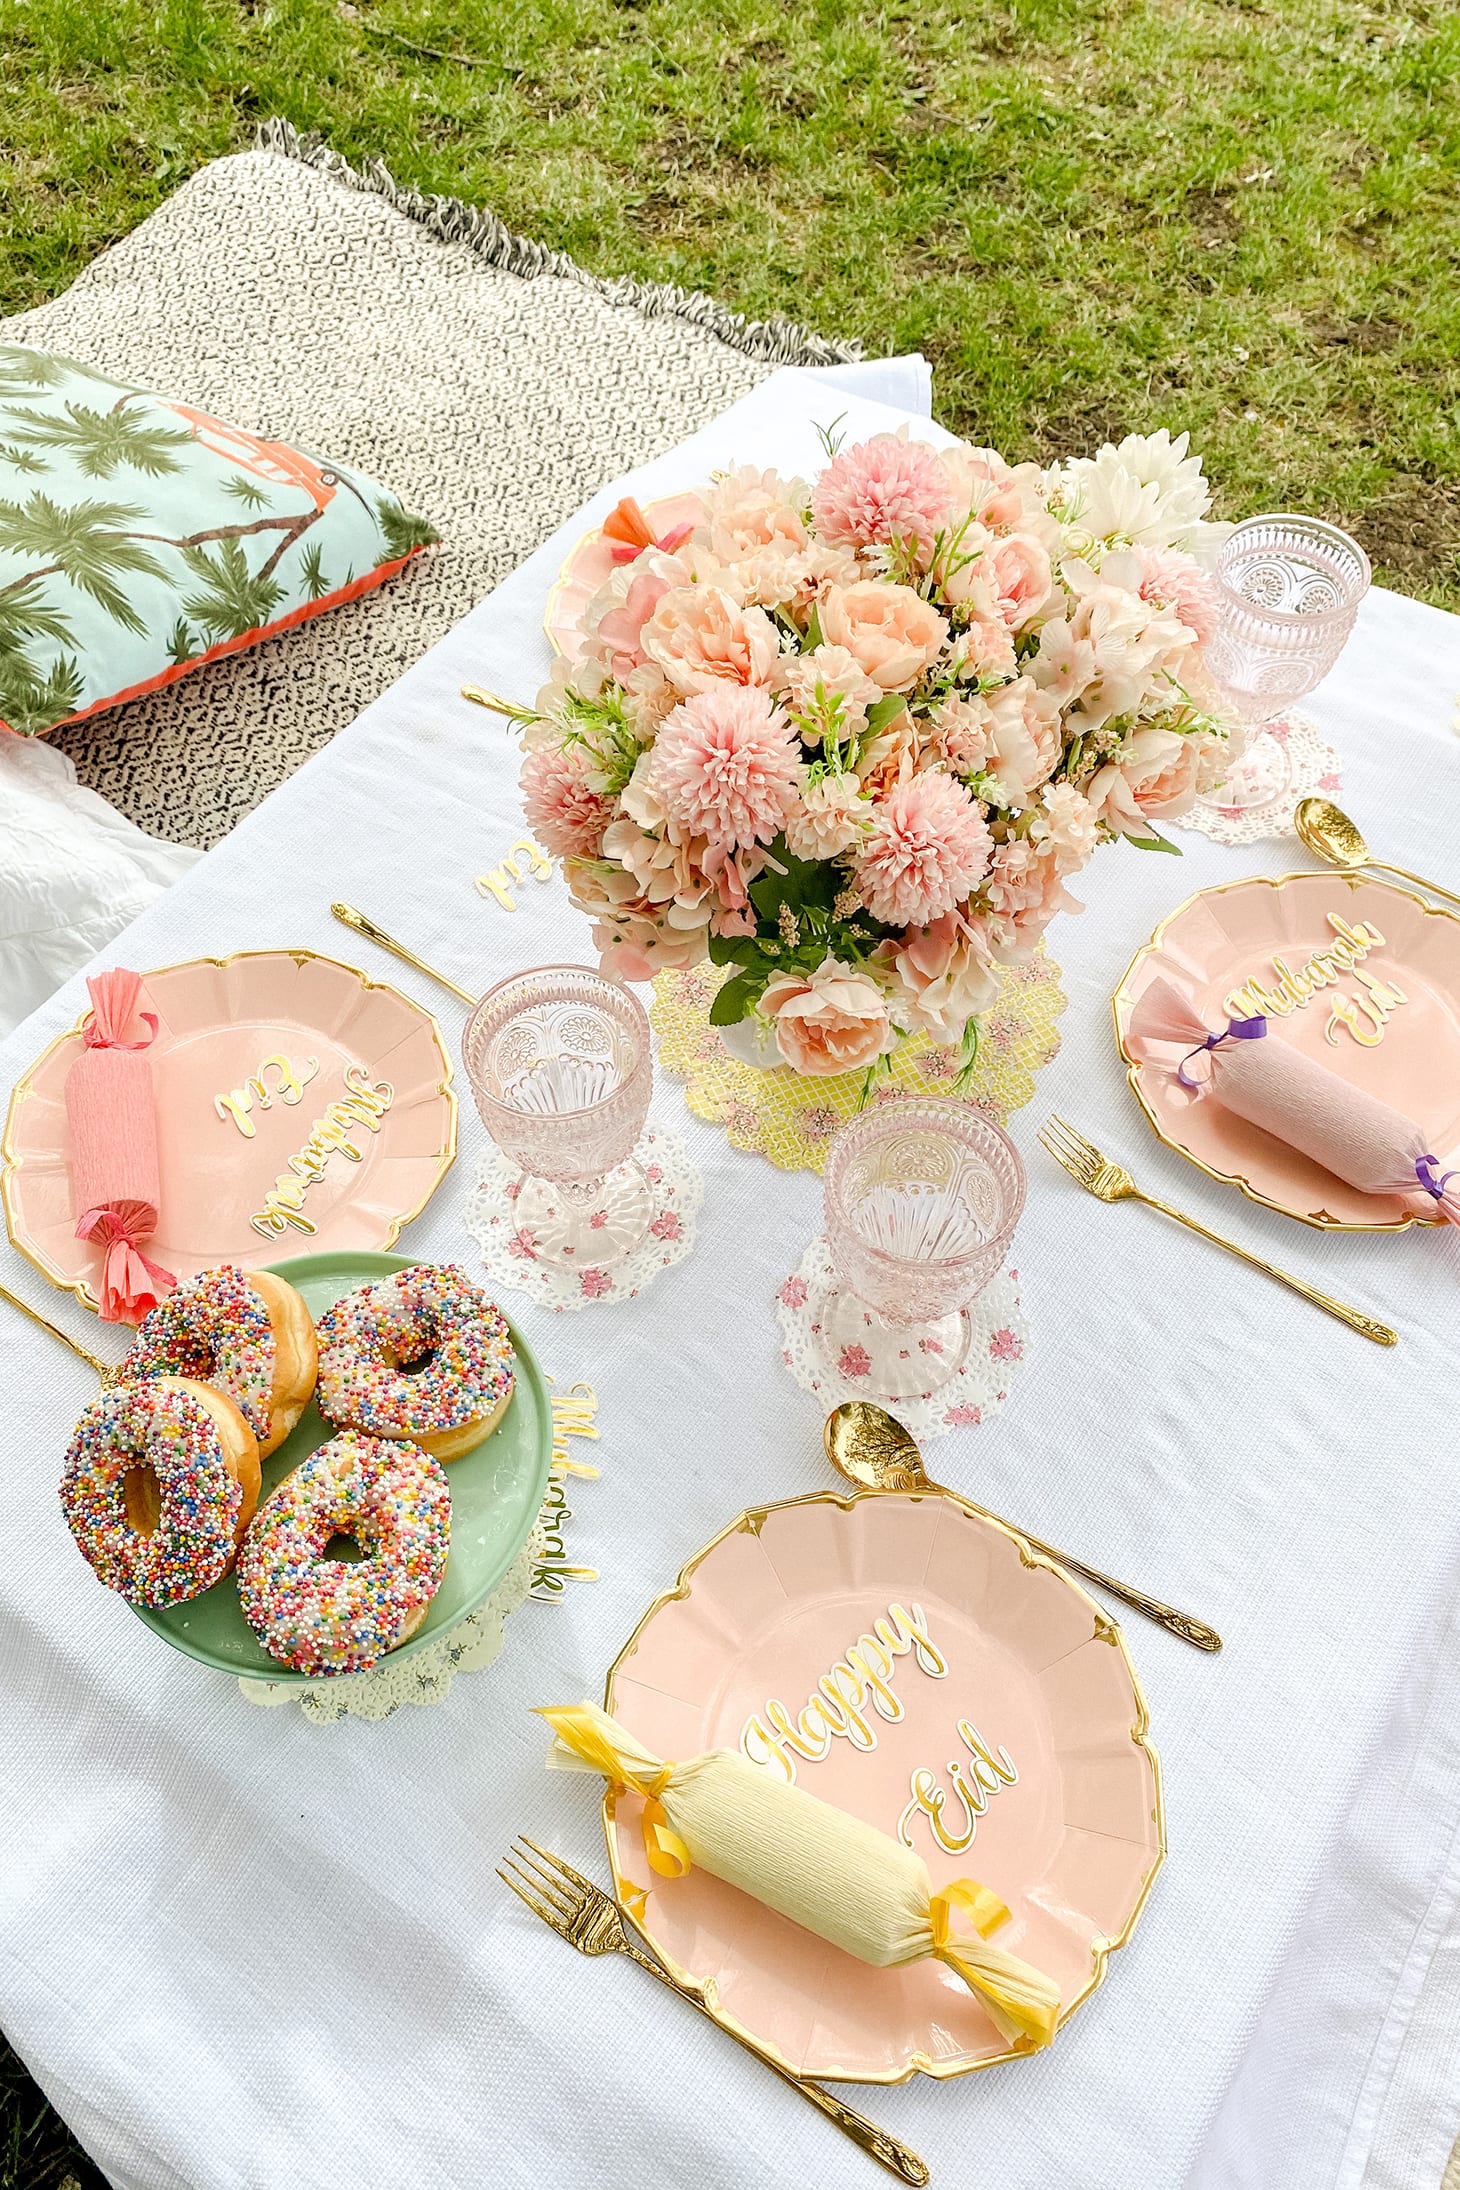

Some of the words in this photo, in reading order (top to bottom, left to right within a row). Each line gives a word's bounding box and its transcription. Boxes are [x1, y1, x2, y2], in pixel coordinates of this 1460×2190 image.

[475, 841, 558, 912] Eid
[1223, 912, 1386, 1021] Mubarak
[1324, 968, 1409, 1047] Eid
[214, 1055, 320, 1138] Eid
[249, 1063, 394, 1240] Mubarak
[741, 1602, 949, 1785] Happy
[898, 1719, 1020, 1855] Eid
